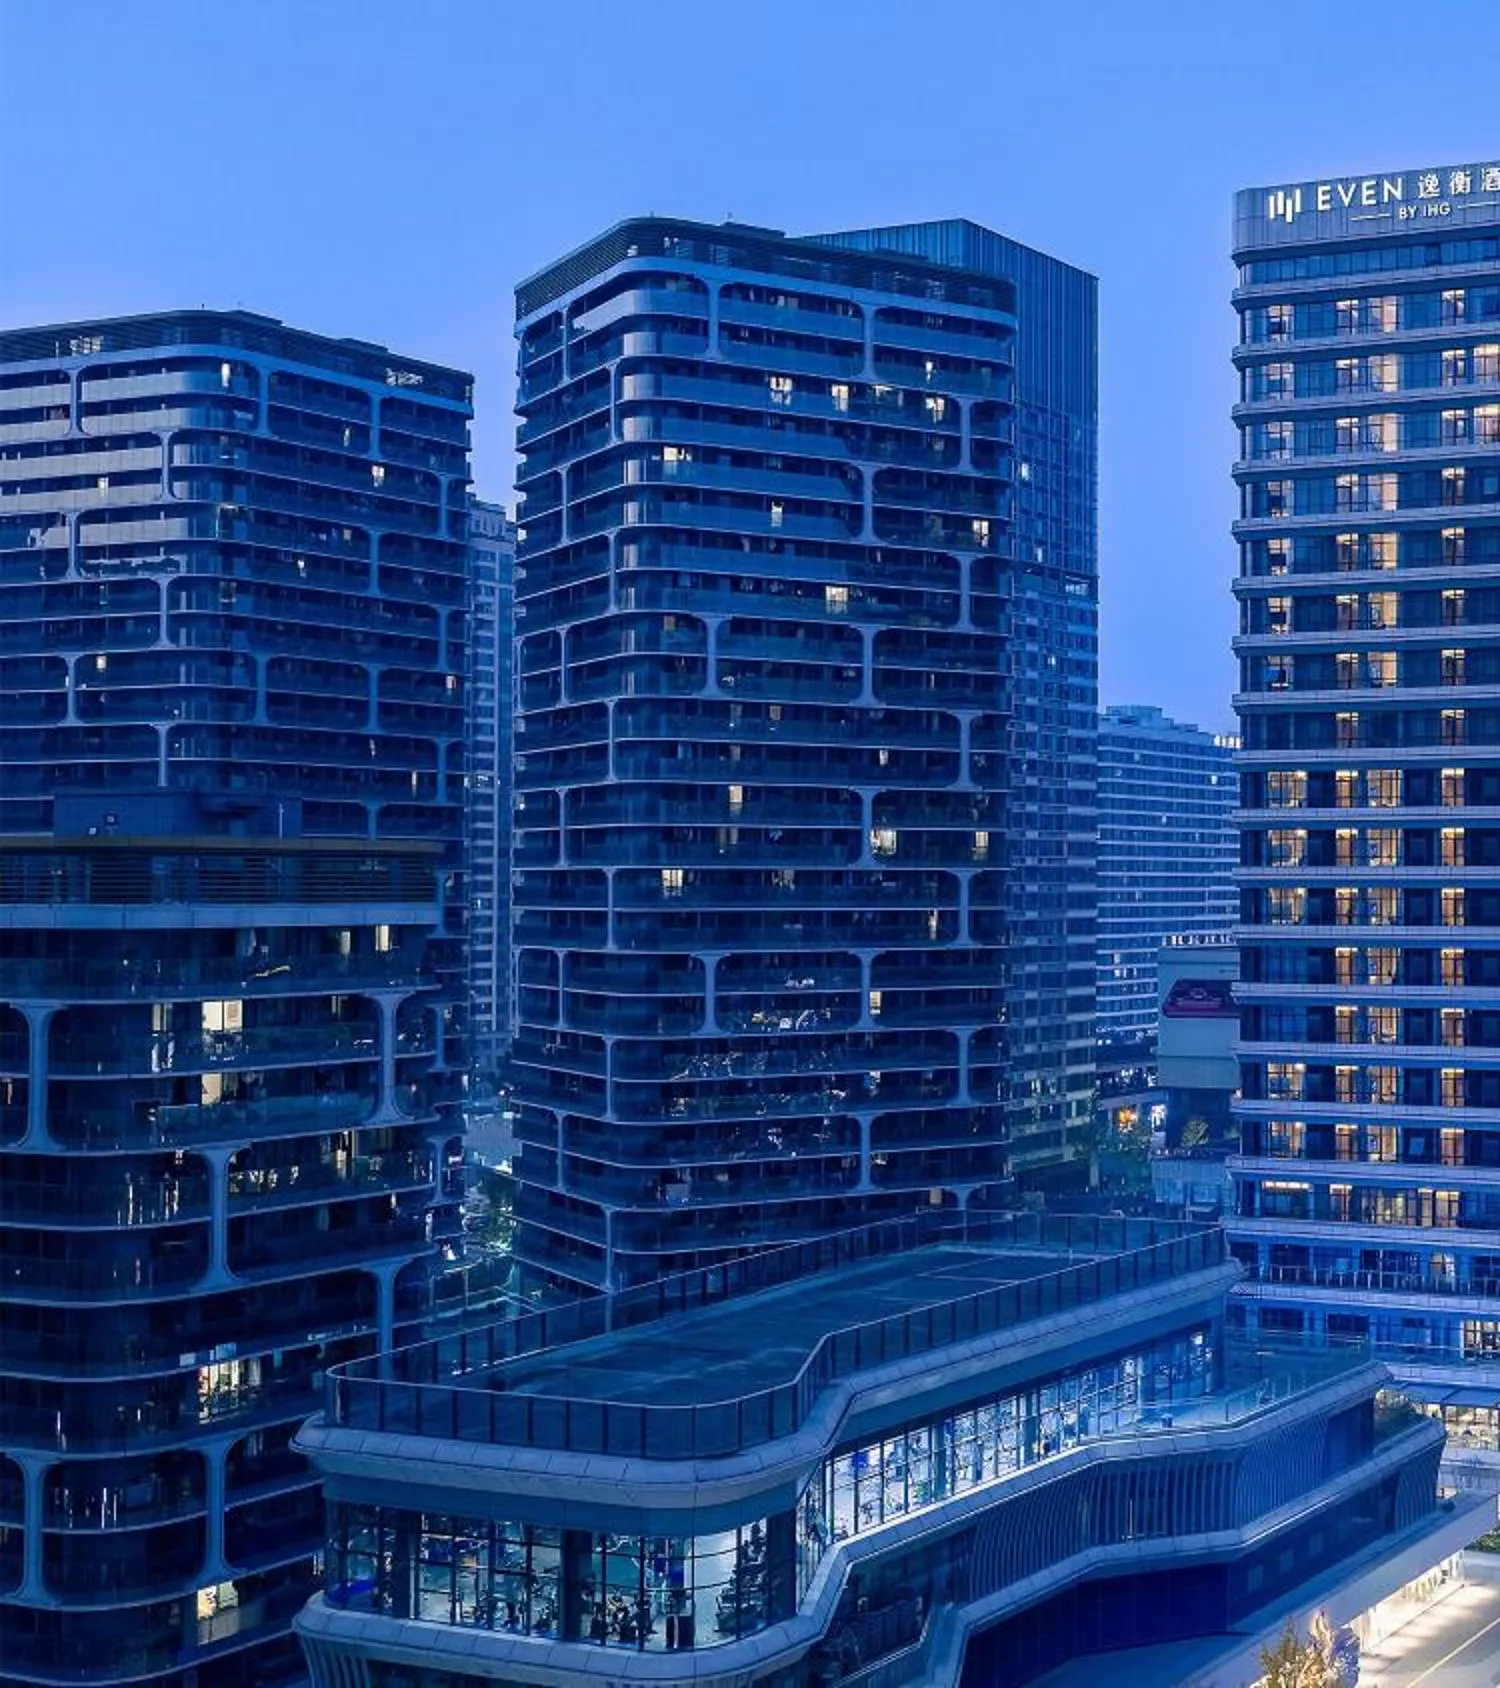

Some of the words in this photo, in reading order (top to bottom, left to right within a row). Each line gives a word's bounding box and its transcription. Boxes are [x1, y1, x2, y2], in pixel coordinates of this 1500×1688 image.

[1317, 177, 1402, 212] EVEN
[1399, 205, 1417, 219] BY
[1423, 202, 1451, 217] IHG
